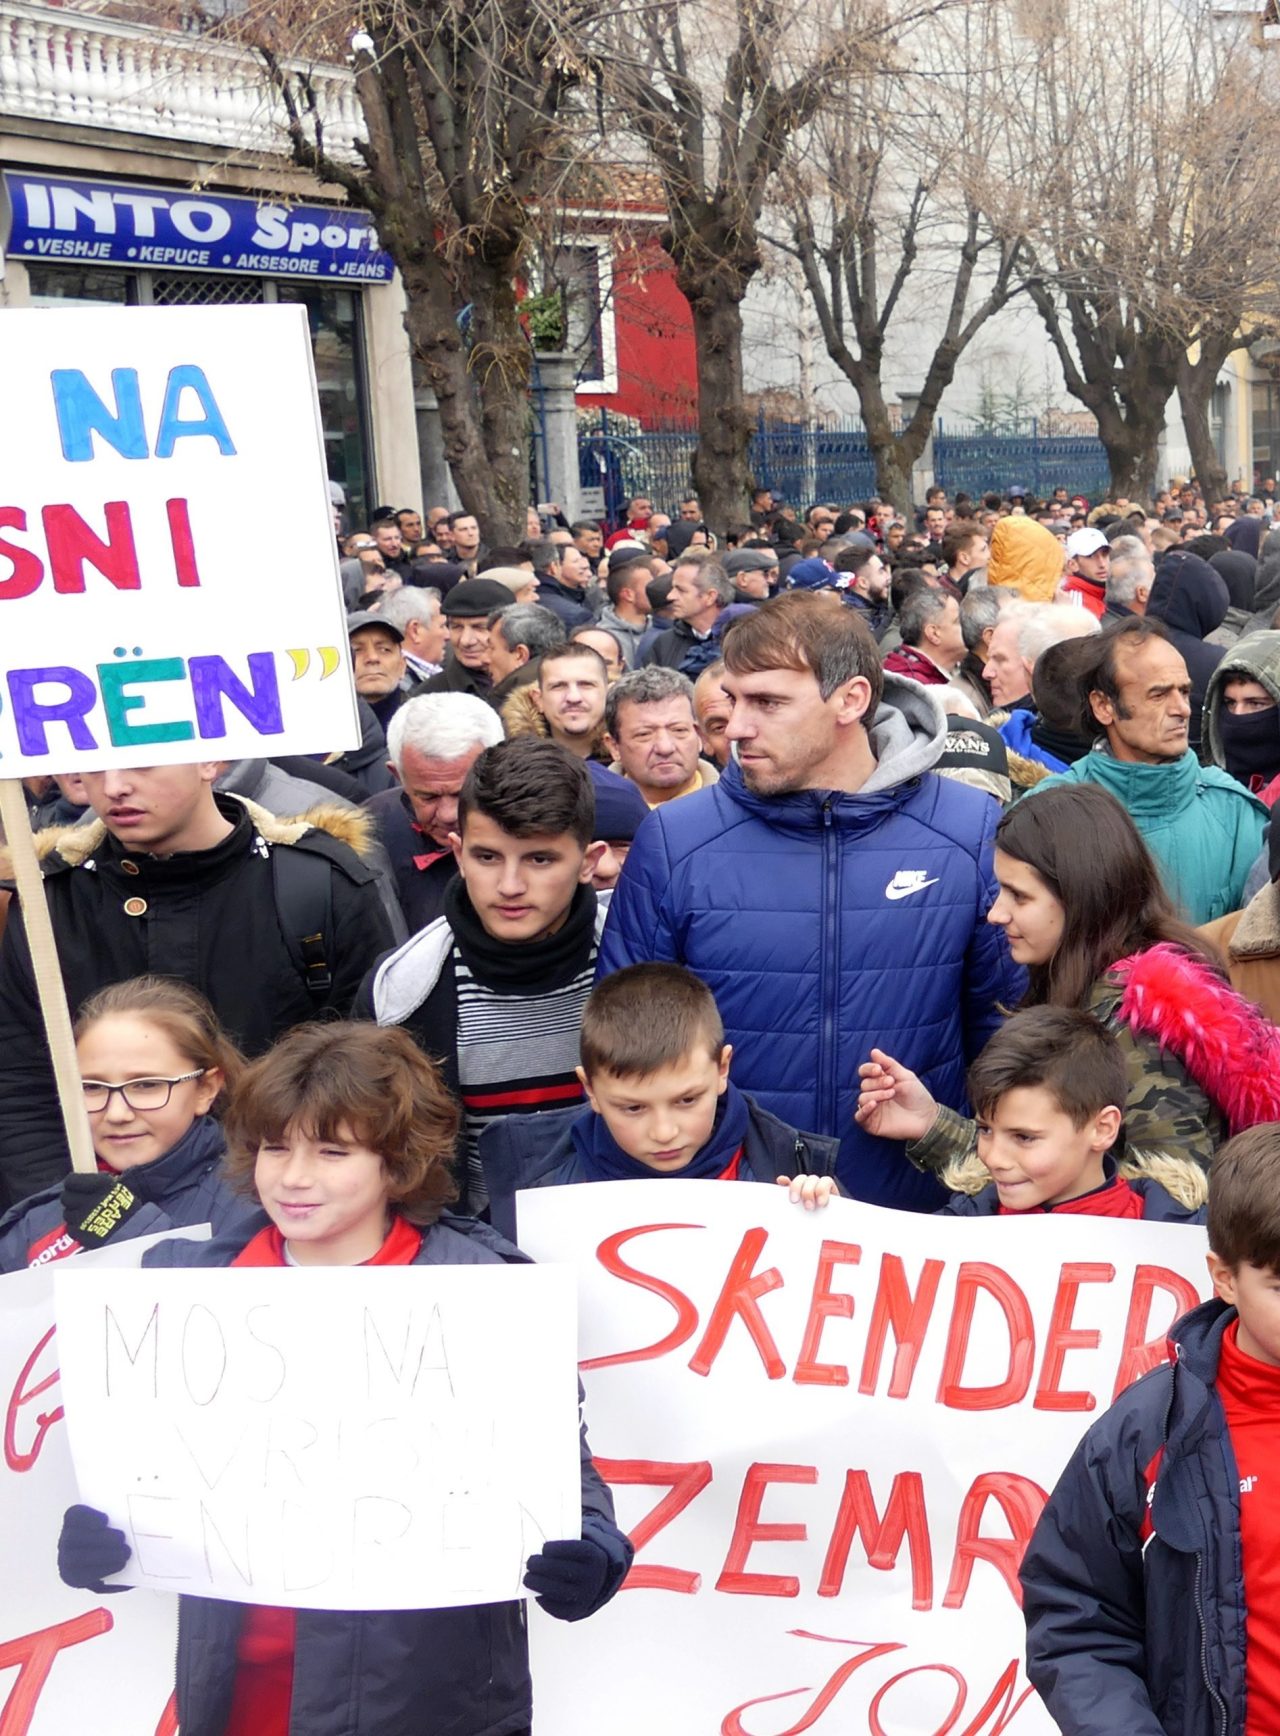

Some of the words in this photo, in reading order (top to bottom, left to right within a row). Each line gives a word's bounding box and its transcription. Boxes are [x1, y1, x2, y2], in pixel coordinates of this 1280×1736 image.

[24, 184, 231, 243] INTO
[38, 239, 113, 258] VESHJE
[140, 247, 210, 265] KEPUCE
[236, 254, 320, 273] AKSESORE
[339, 262, 386, 279] JEANS
[50, 365, 237, 462] NA
[945, 738, 990, 753] VANS
[895, 870, 927, 887] NIKE
[578, 1223, 1220, 1411] SKENDER
[105, 1302, 287, 1406] MOS
[364, 1302, 456, 1400] NA
